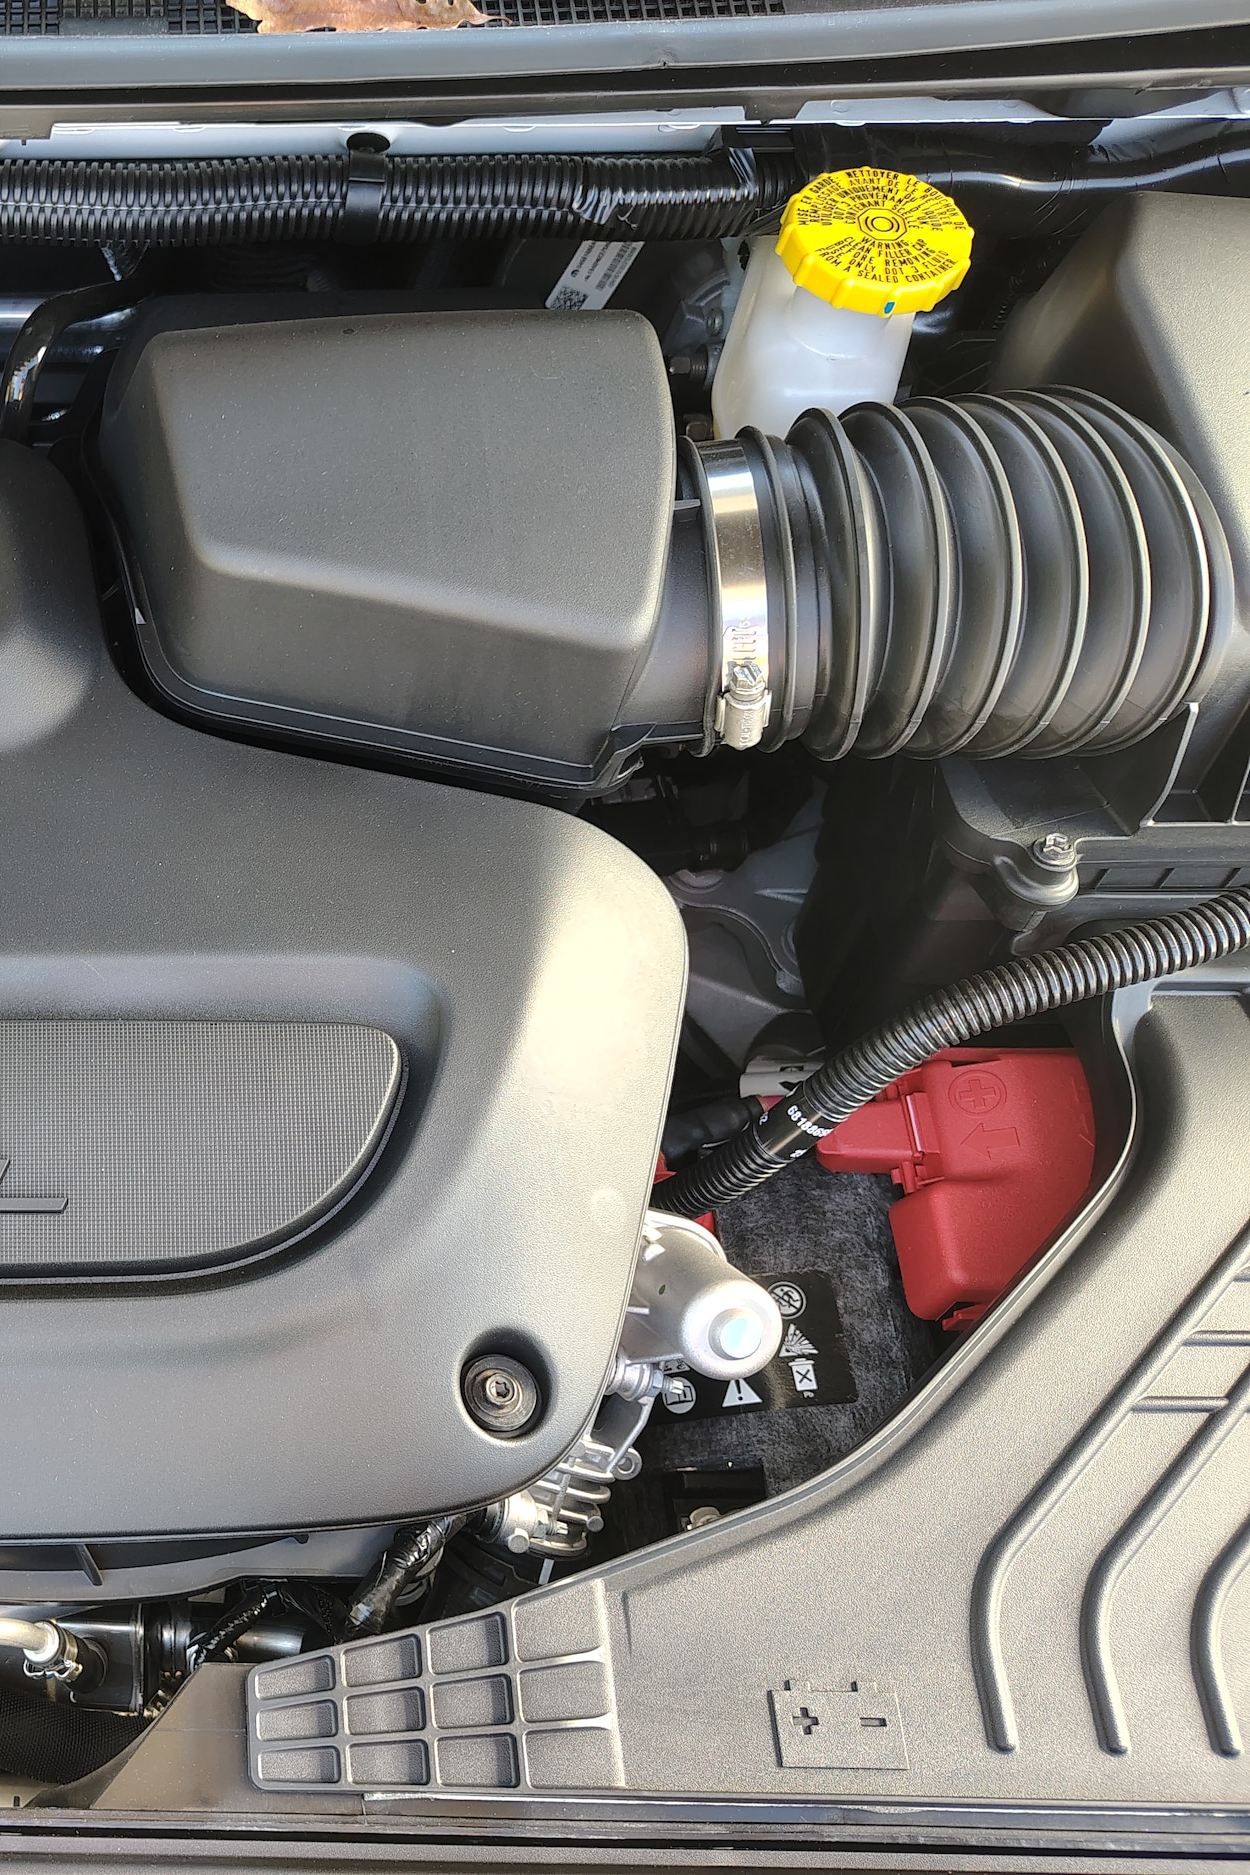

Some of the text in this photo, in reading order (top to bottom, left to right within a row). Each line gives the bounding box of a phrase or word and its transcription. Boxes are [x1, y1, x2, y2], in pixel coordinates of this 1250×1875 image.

[845, 169, 899, 180] NETTOYER
[907, 178, 920, 188] LE
[800, 195, 813, 205] EN
[809, 178, 952, 226] REMPLISSAGE AVANT DE LE RETIRER
[821, 184, 943, 231] UTILISER UNIQUEMENT DU LIQUIDE
[832, 206, 847, 220] DOT
[849, 192, 909, 207] PROVENANT
[845, 200, 885, 224] CONTENANT
[924, 187, 959, 217] BOUCHON
[797, 208, 809, 226] MISE
[954, 221, 966, 230] DE
[825, 244, 949, 275] USE ONLY DOT 3 FLUID
[834, 240, 936, 267] BEFORE REMOVING
[844, 236, 927, 258] CLEAN FILLER CAP
[814, 247, 842, 267] FROM
[857, 270, 899, 283] SEALED
